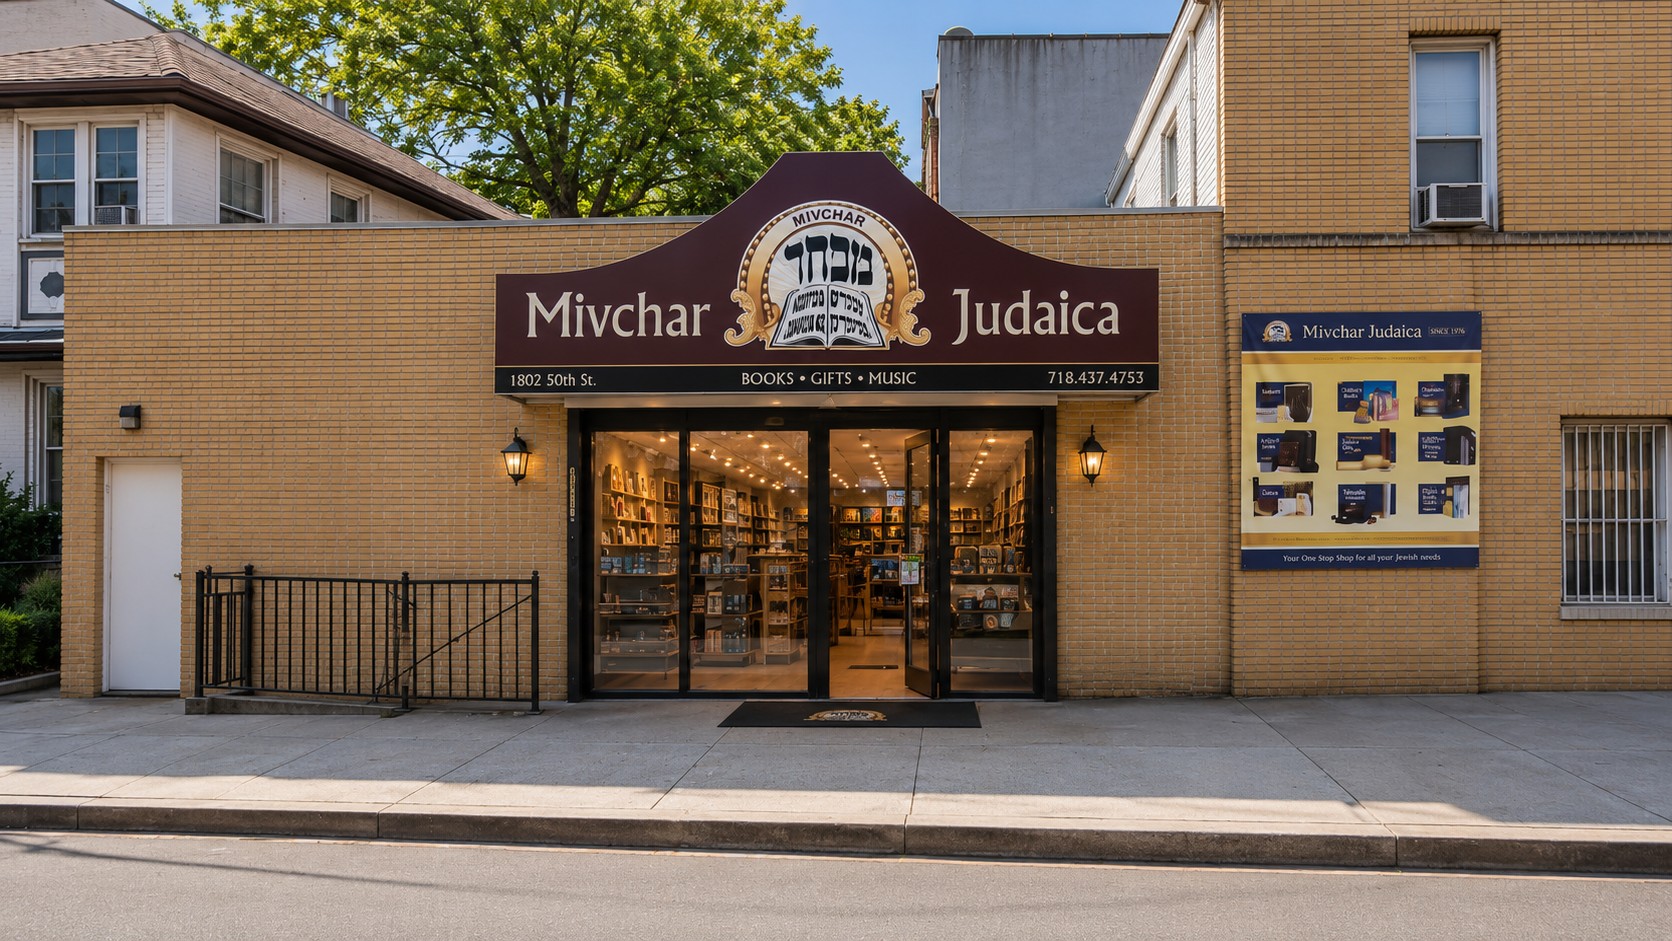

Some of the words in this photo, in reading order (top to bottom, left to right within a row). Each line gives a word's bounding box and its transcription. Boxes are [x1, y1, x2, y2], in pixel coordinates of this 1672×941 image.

[792, 208, 866, 228] MIVCHAR
[525, 291, 711, 338] Mivchar
[952, 288, 1120, 345] Judaica
[1303, 324, 1365, 339] Mivchar
[1369, 324, 1422, 340] Judaica
[510, 374, 542, 387] 1802
[547, 373, 576, 387] 50th
[580, 373, 597, 387] St.
[741, 372, 794, 385] BOOKS
[810, 372, 852, 385] GIFTS
[868, 371, 917, 385] MUSIC
[1048, 371, 1144, 384] 718.437.4753
[1318, 554, 1334, 563] Stop
[1336, 554, 1354, 563] Shop
[1377, 555, 1393, 563] your
[1395, 553, 1418, 562] Jewish
[1420, 553, 1441, 561] needs
